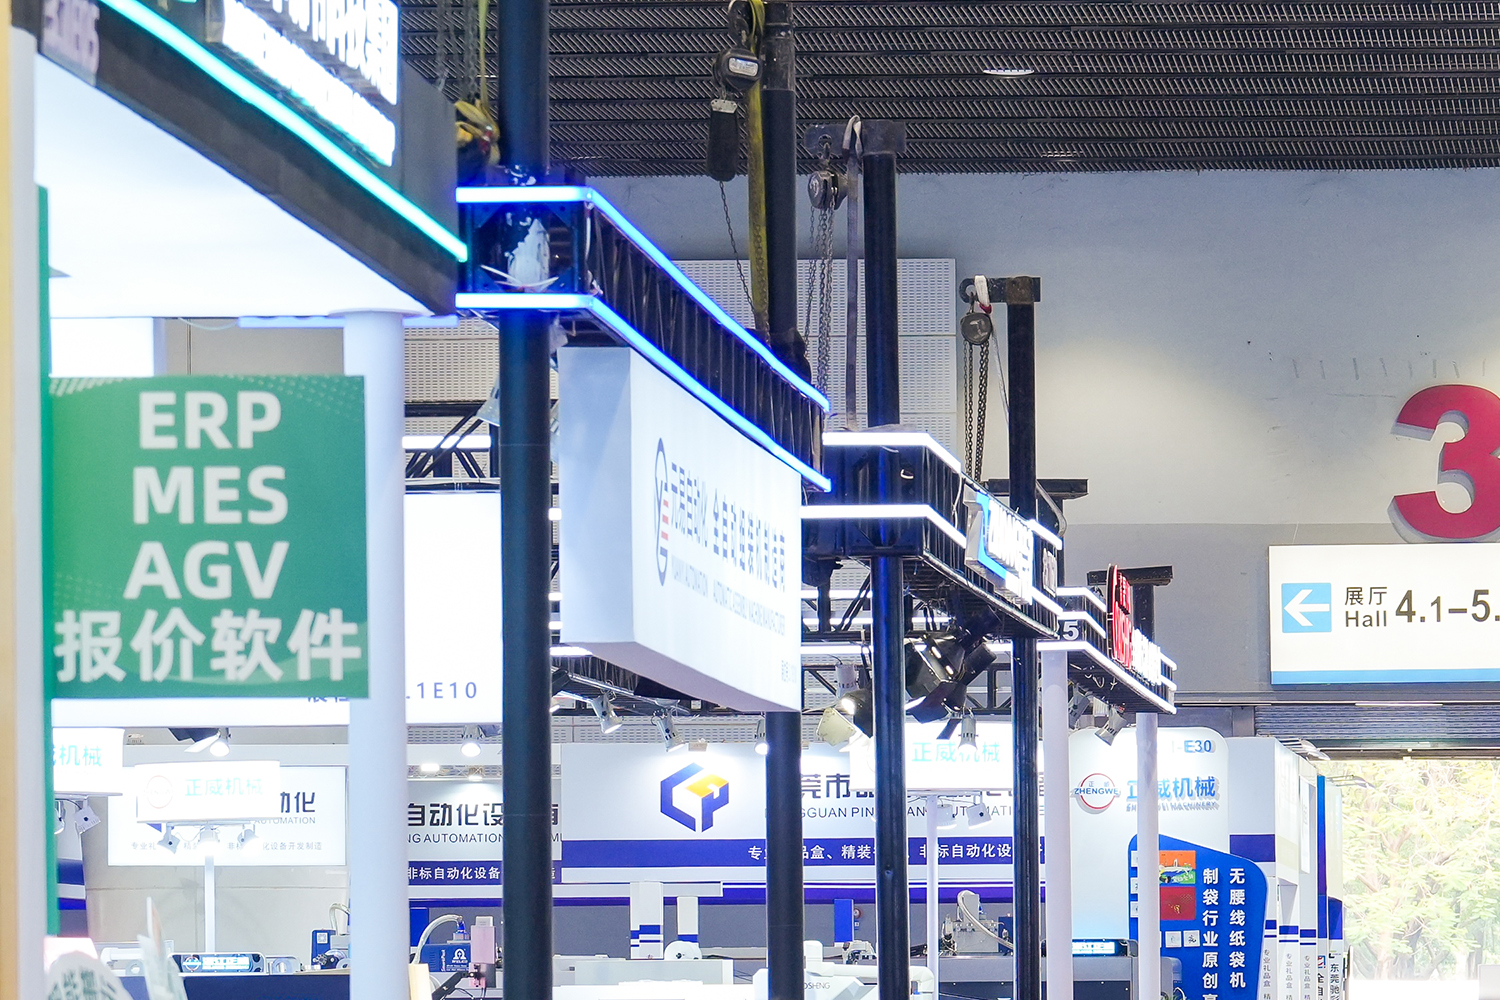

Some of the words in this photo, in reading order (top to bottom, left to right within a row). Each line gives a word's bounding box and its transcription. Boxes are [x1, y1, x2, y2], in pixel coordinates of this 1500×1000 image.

[139, 391, 282, 449] ERP
[133, 466, 289, 524] MES
[123, 541, 290, 600] AGV
[1344, 586, 1388, 606] 展厅
[54, 607, 362, 683] 报价软件
[1345, 610, 1388, 628] Hall
[52, 745, 102, 767] 机械
[185, 778, 263, 796] 正威机械
[1229, 867, 1247, 988] 无腰线纸袋机
